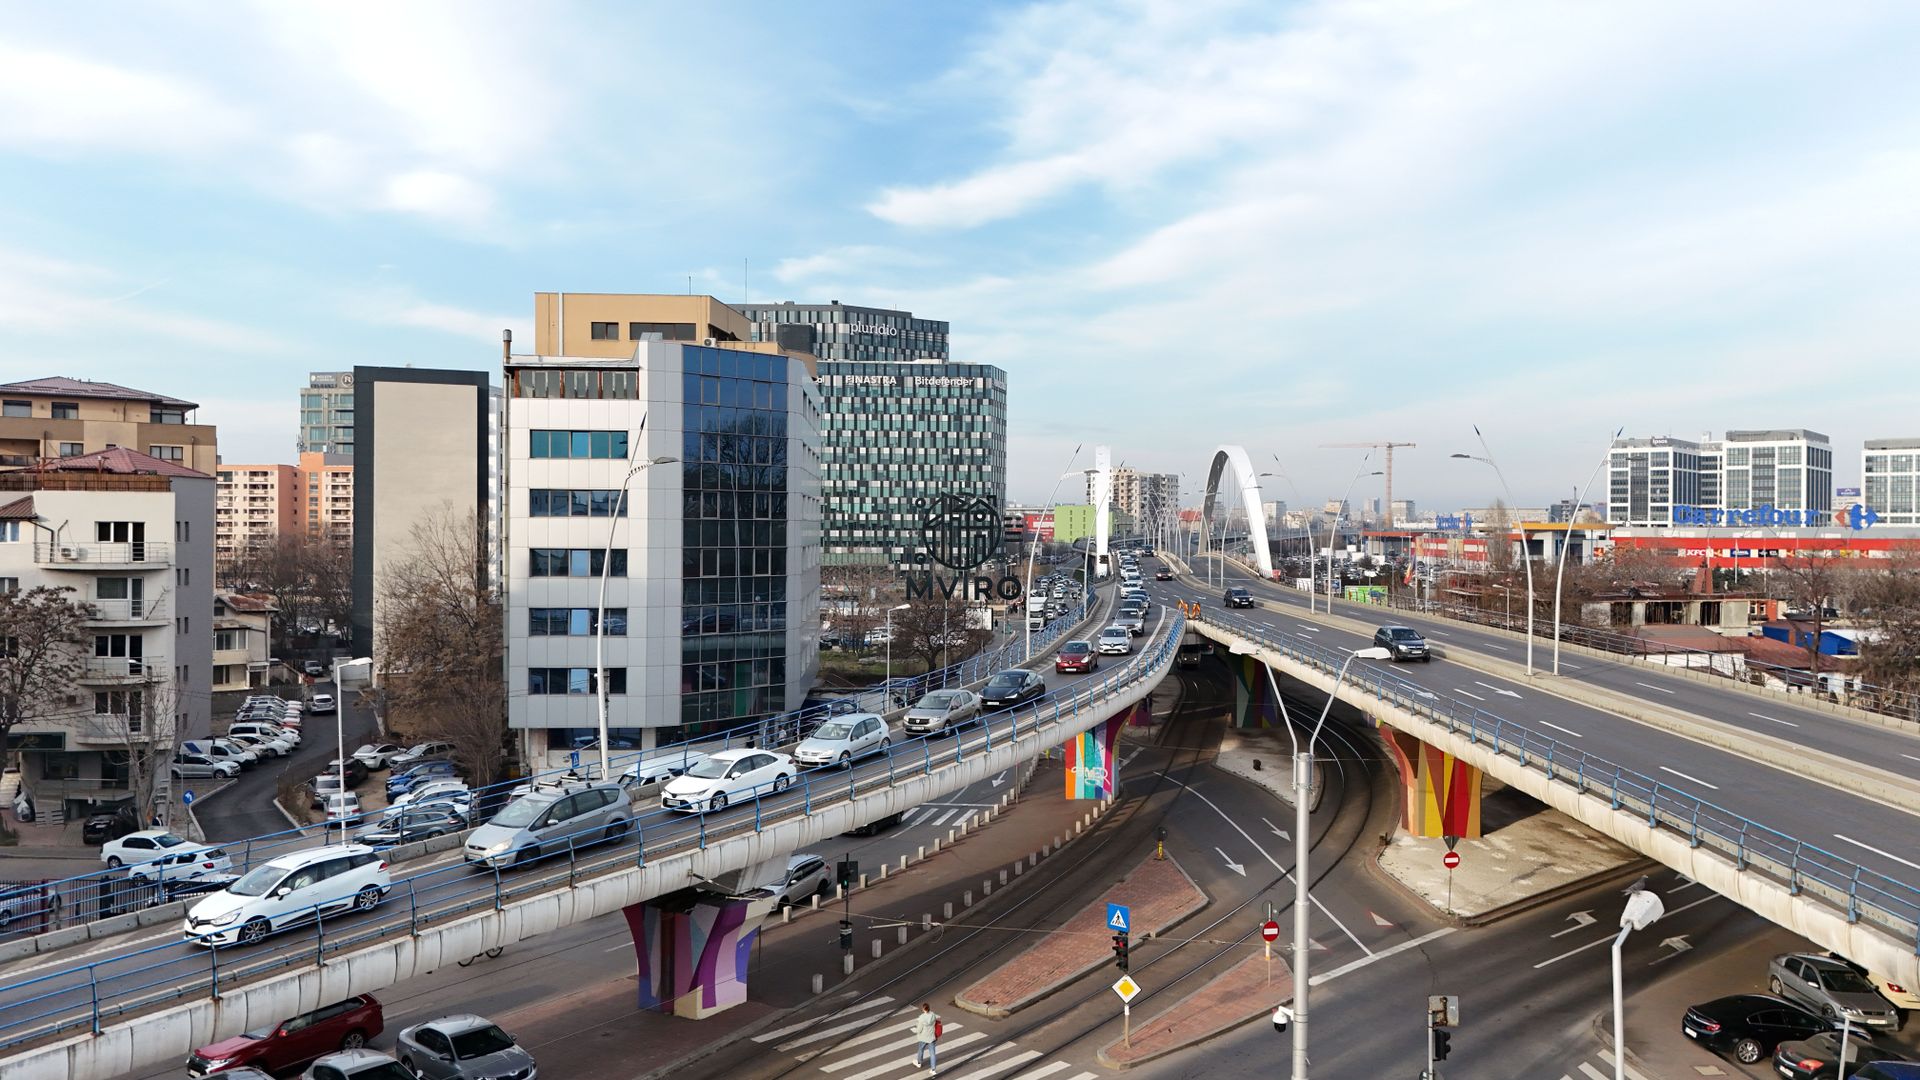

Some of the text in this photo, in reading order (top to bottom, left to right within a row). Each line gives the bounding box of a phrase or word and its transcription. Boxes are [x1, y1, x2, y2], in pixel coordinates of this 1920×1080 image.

[850, 321, 897, 336] pluridio
[845, 375, 897, 385] FINASTRA
[914, 376, 973, 387] Bitdefender
[1673, 504, 1820, 525] Carrefour
